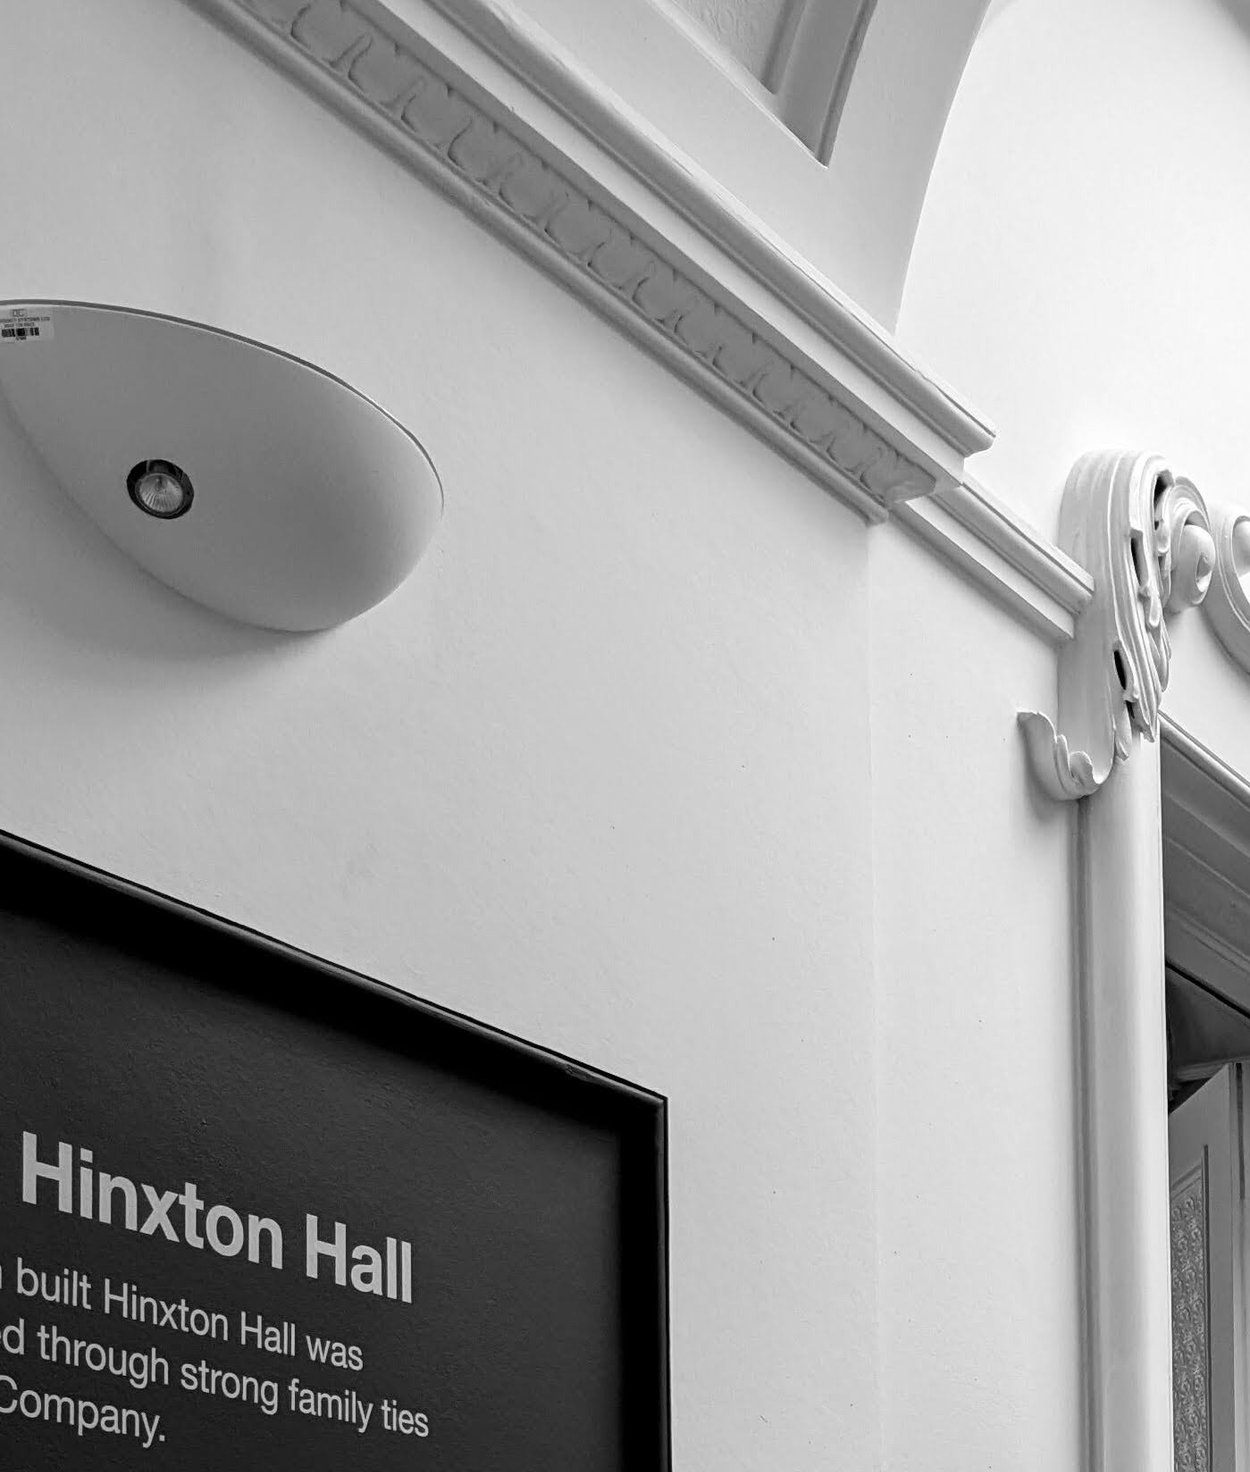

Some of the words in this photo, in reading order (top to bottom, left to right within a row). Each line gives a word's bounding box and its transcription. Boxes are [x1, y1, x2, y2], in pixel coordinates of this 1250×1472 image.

[22, 1130, 283, 1270] Hinxton
[305, 1213, 412, 1304] Hall
[17, 1256, 92, 1310] built
[104, 1277, 228, 1341] Hinxton
[240, 1311, 296, 1357] Hall
[305, 1334, 364, 1371] was
[0, 1374, 166, 1448] Company.
[37, 1323, 169, 1390] through
[180, 1359, 278, 1415] strong
[288, 1378, 374, 1434] family
[381, 1400, 429, 1438] ties
